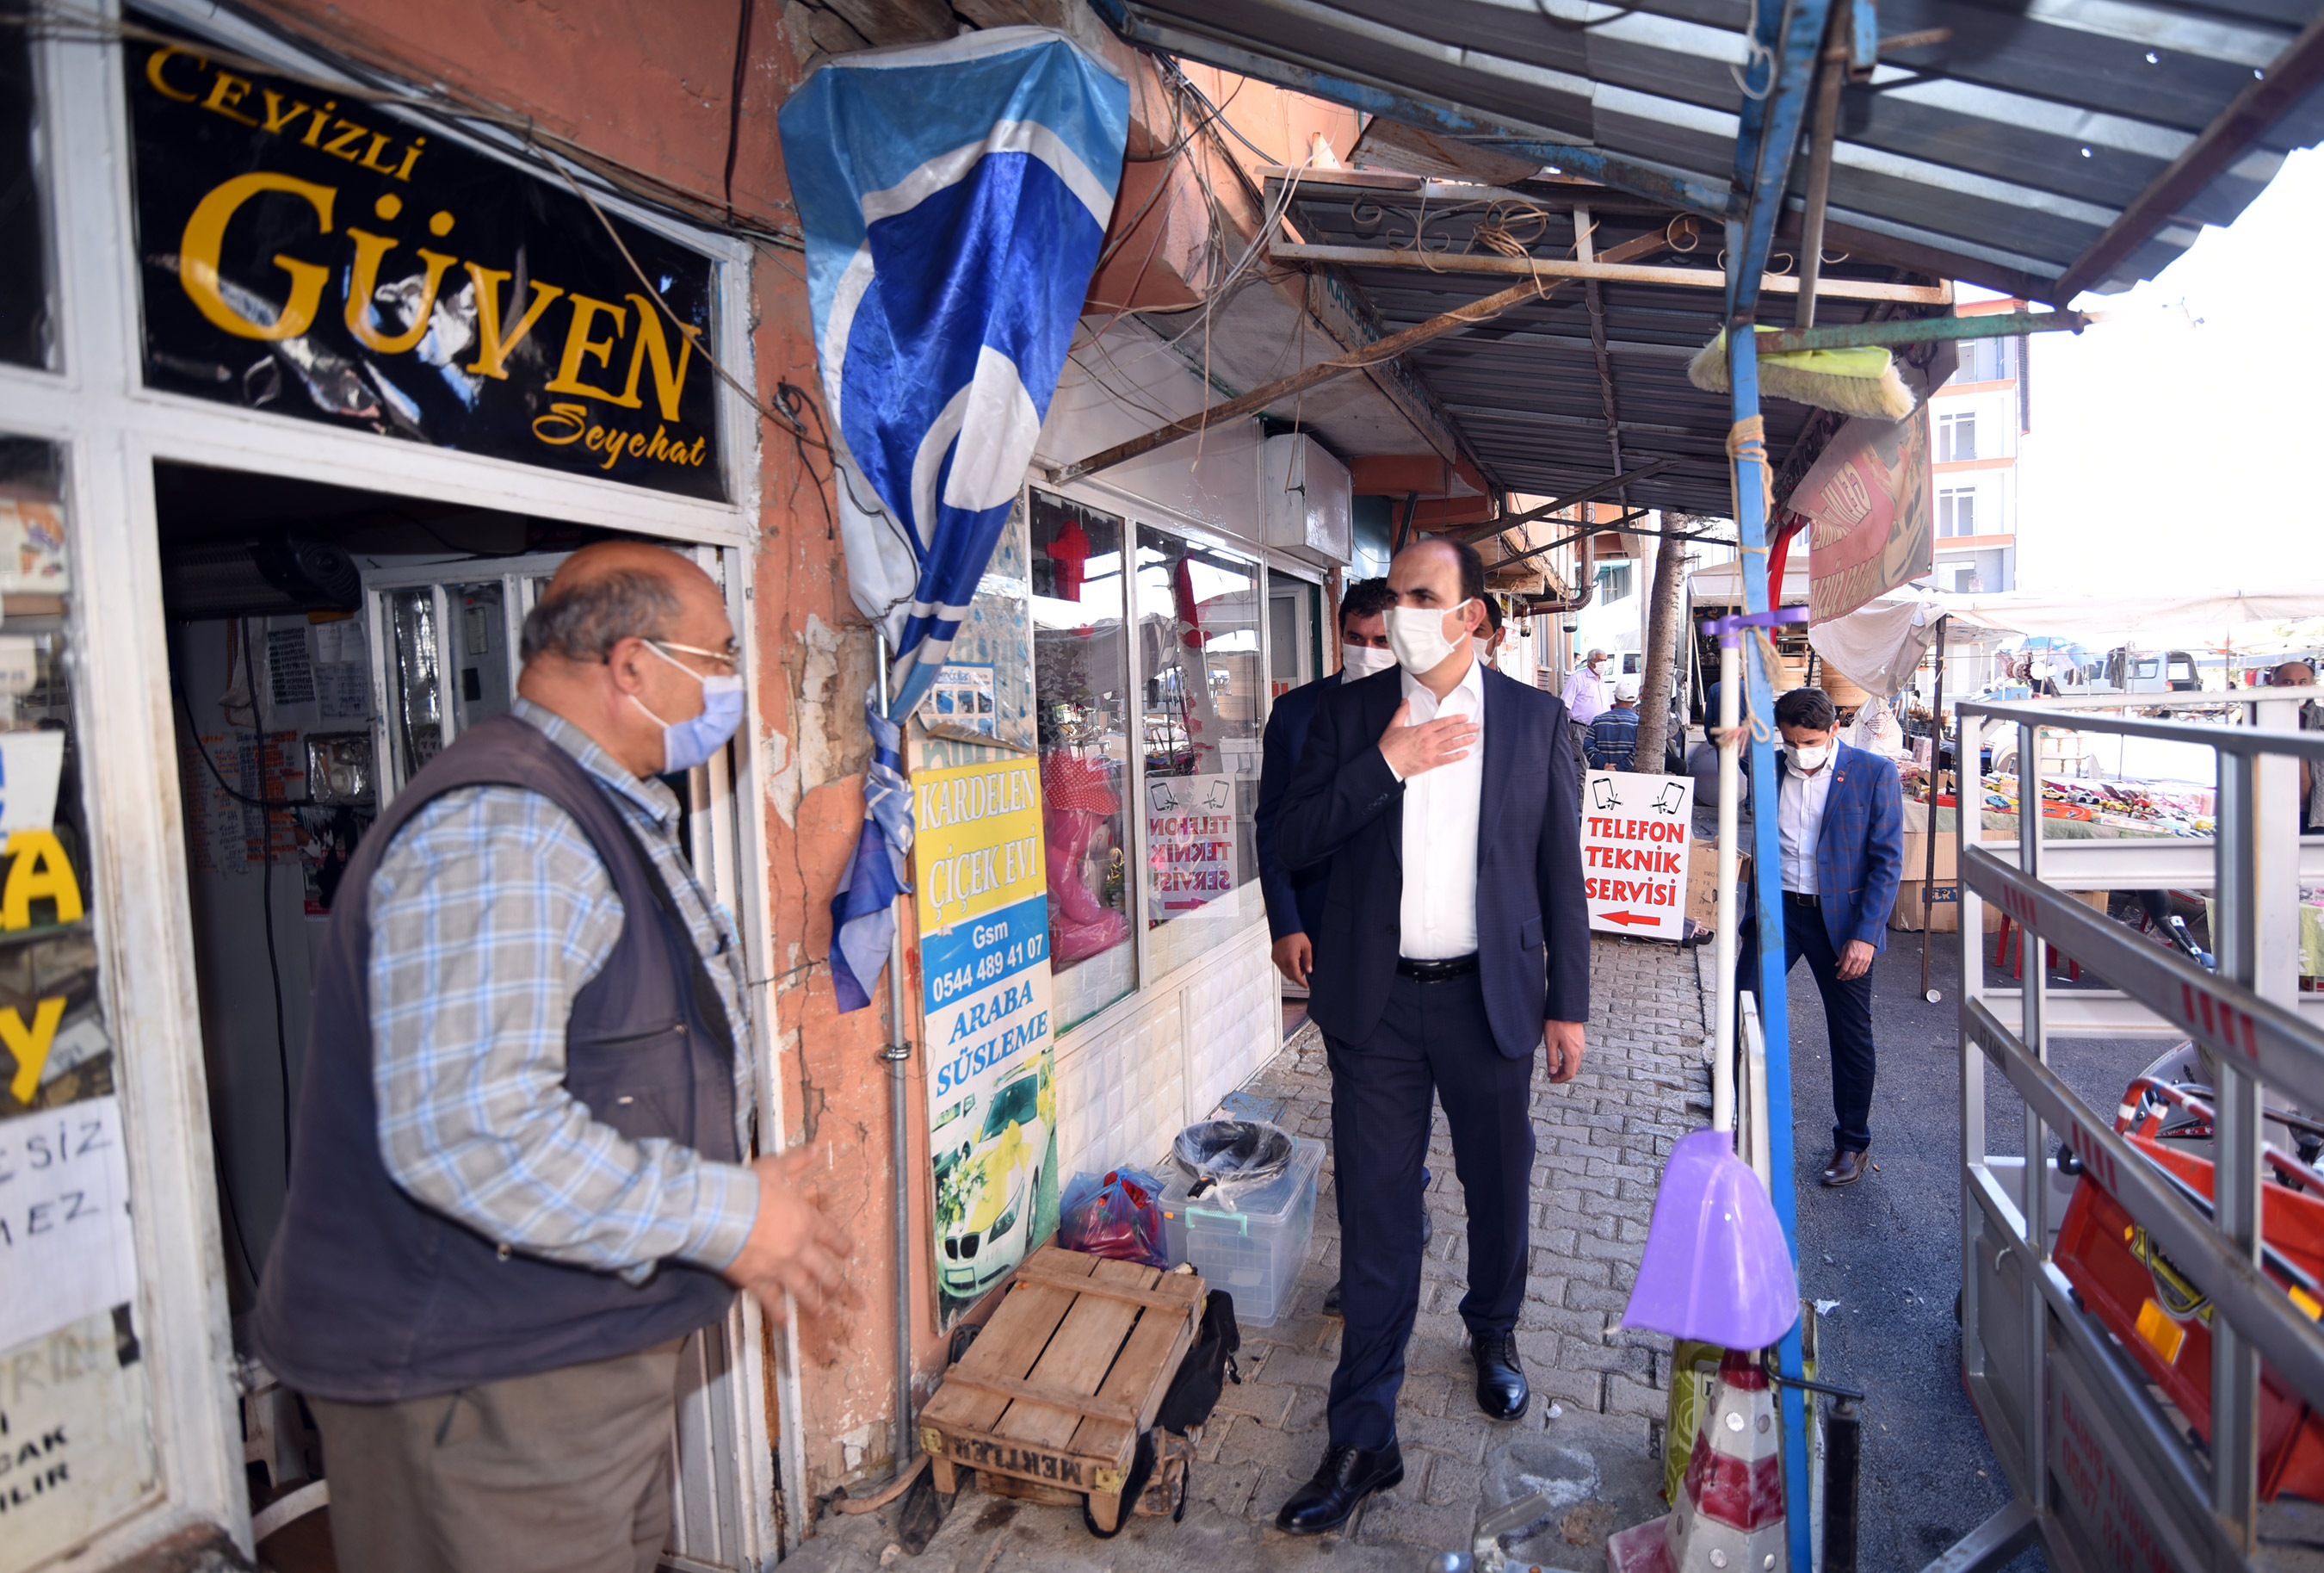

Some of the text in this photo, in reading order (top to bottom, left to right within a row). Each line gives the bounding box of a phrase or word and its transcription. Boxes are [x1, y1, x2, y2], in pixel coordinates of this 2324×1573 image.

[180, 172, 702, 422] GÜVEN
[532, 402, 706, 470] Seyehat
[919, 768, 1035, 831] KARDELEN
[1587, 817, 1684, 843] TELEFON
[929, 824, 1037, 921] ÇİÇEK EVİ
[1585, 845, 1681, 874] TEKNİK
[1585, 876, 1676, 907] SERVİSİ
[933, 933, 1043, 1002] 0544 489 41 07
[973, 921, 1008, 950] Gsm
[948, 979, 1034, 1046] ARABA
[936, 1010, 1048, 1098] SÜSLEME
[954, 1435, 1082, 1486] MERTLER
